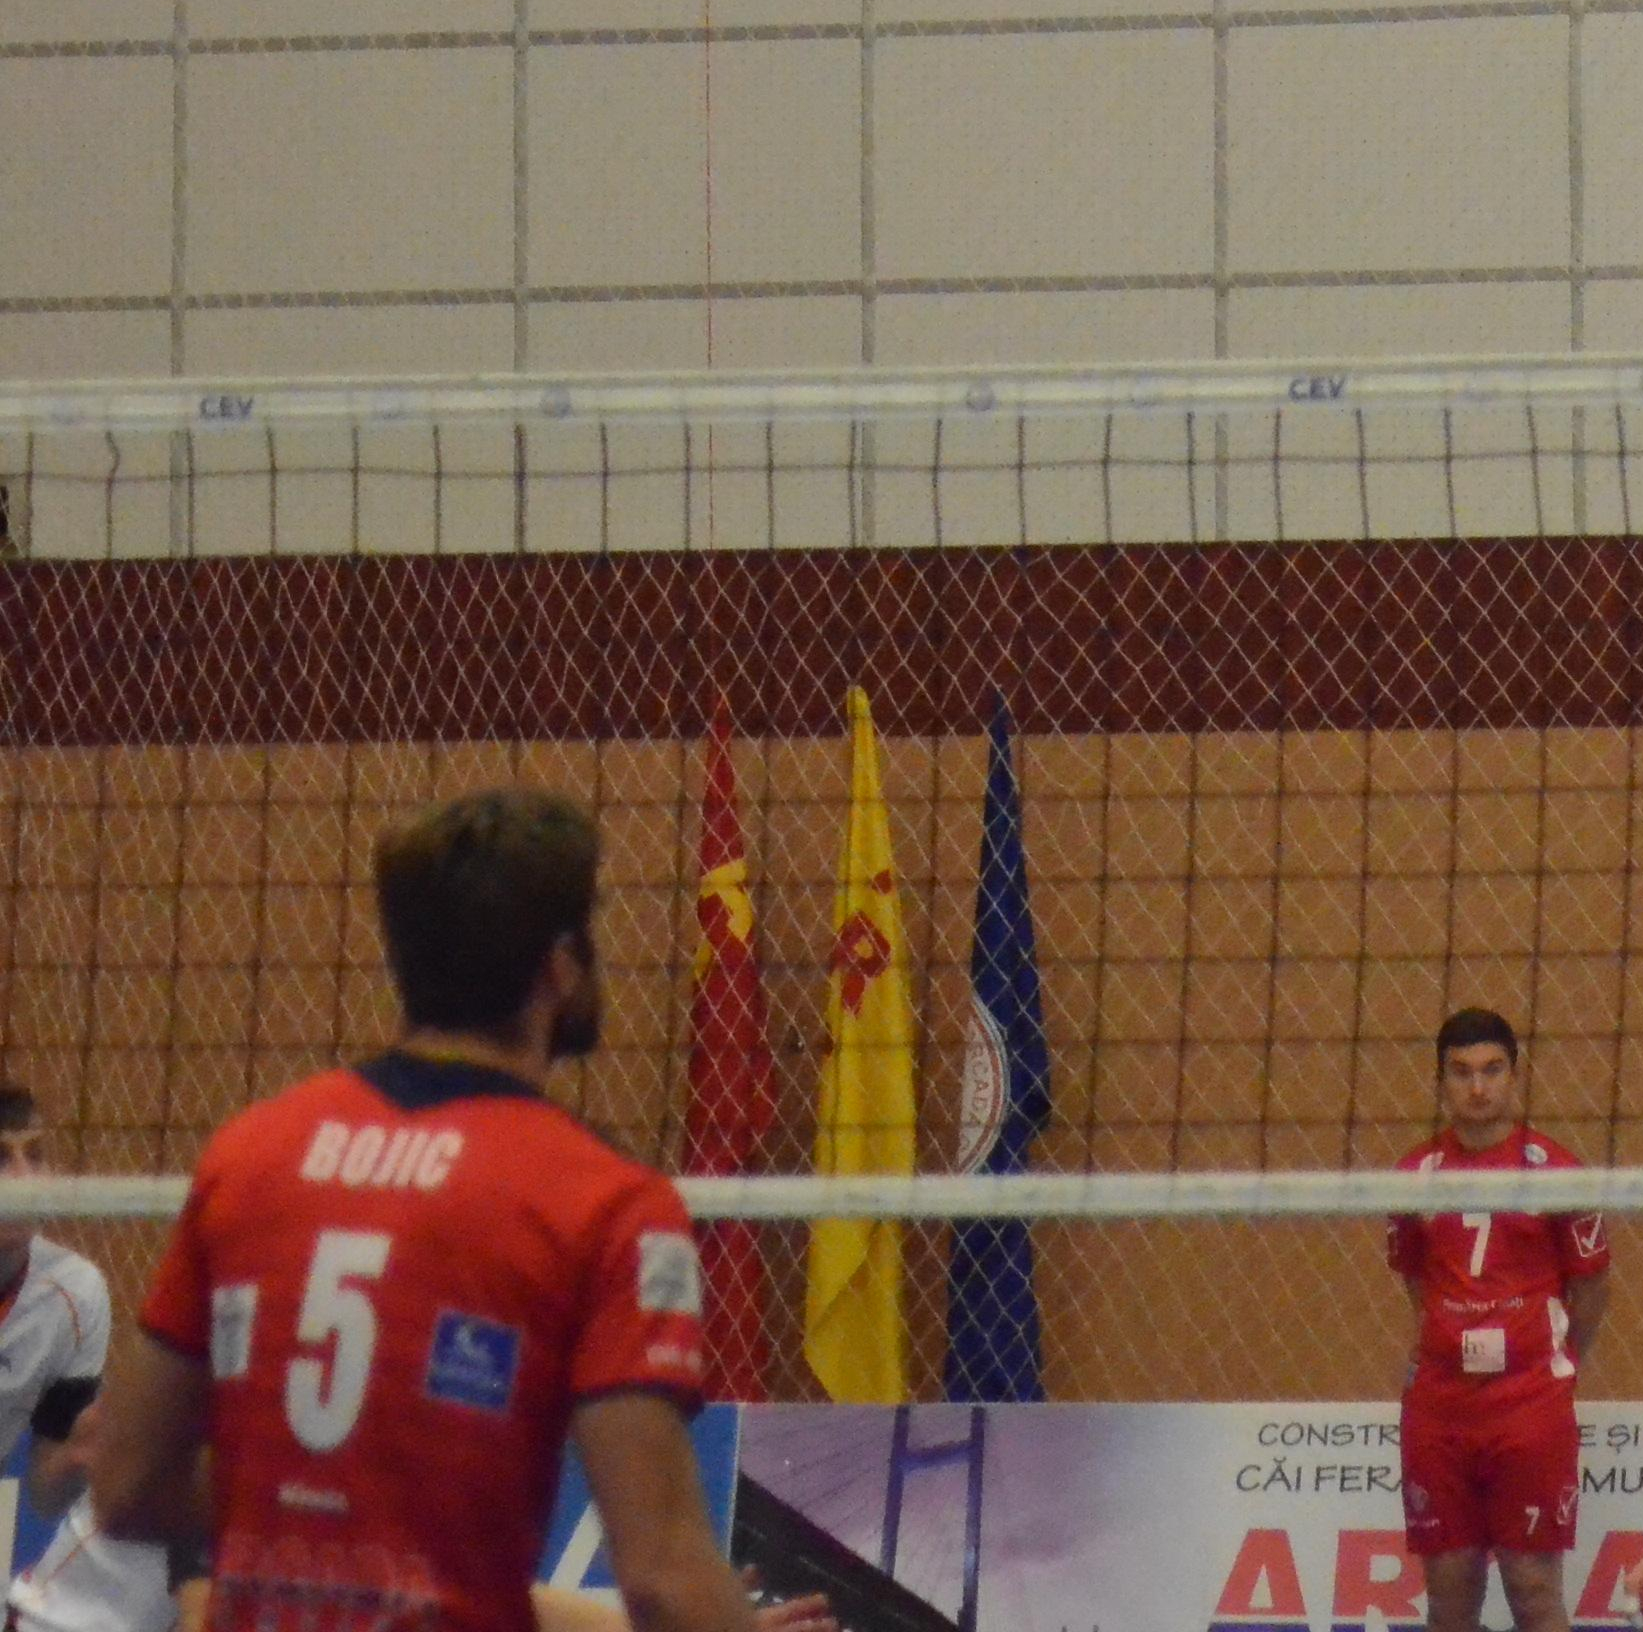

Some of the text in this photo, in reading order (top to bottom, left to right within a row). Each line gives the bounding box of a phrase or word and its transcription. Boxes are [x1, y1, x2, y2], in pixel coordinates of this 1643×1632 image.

[1289, 377, 1346, 403] CEV
[201, 397, 253, 421] CEV
[1462, 1212, 1492, 1277] 7
[284, 1231, 392, 1450] 5
[1258, 1423, 1400, 1447] CONSTR
[1235, 1456, 1301, 1493] CĂI
[1525, 1505, 1540, 1536] 7
